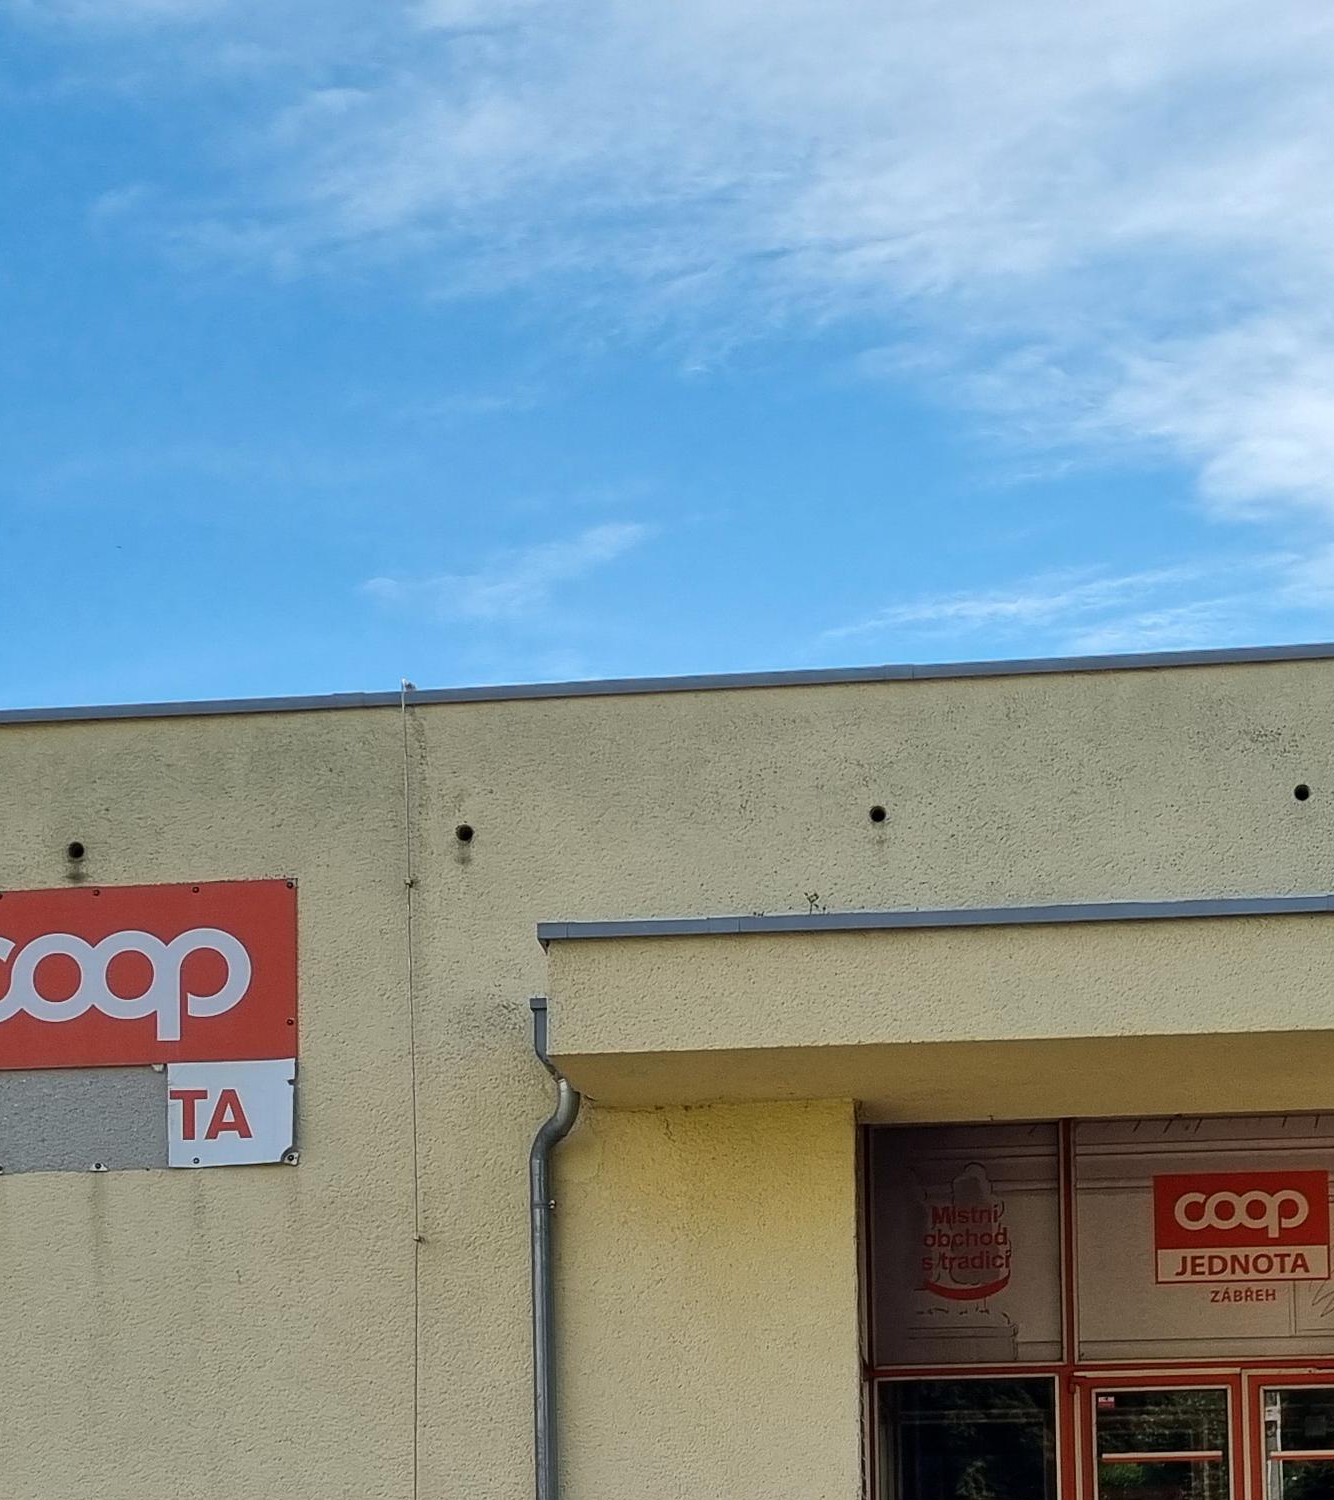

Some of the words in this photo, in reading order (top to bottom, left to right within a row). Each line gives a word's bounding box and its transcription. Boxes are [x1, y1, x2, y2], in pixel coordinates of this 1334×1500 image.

[169, 1089, 253, 1141] TA
[1174, 1189, 1309, 1238] coop
[923, 1227, 1007, 1247] obchod
[922, 1257, 933, 1271] s
[941, 1250, 1010, 1270] tradicí
[1174, 1252, 1310, 1276] JEDNOTA
[1210, 1287, 1276, 1303] ZÁBŘEH
